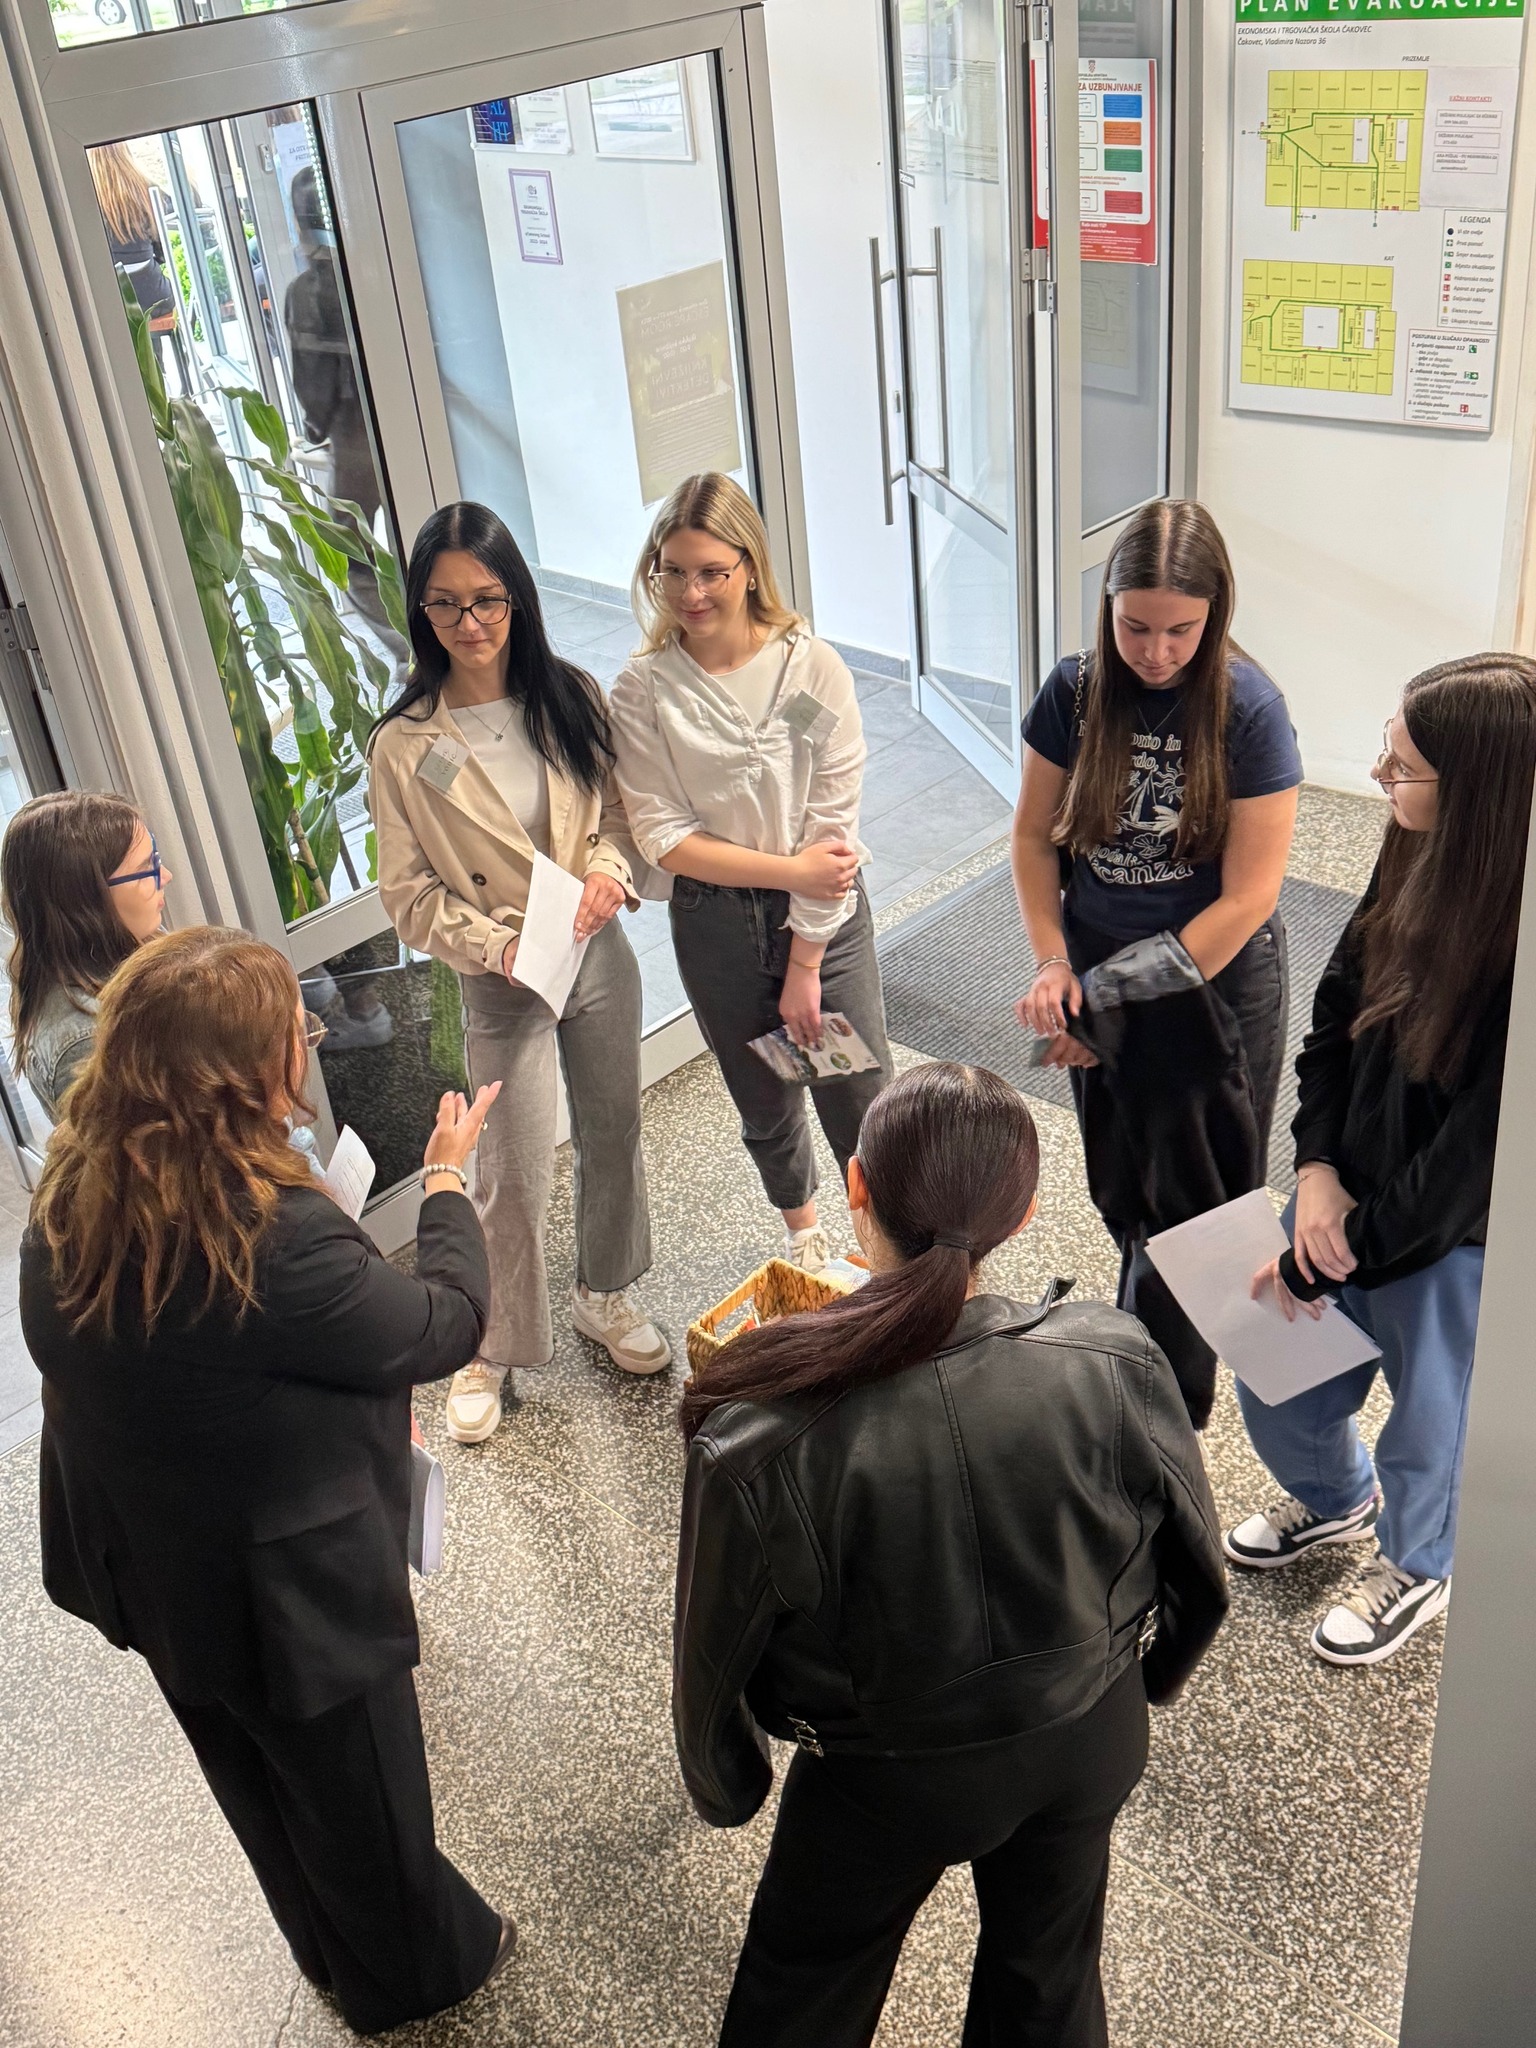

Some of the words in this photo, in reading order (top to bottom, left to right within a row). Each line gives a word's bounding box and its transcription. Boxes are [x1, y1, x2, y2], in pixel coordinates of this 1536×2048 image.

[1240, 0, 1309, 13] PLAN
[1238, 27, 1276, 35] EKONOMSKA
[1282, 26, 1320, 34] TRGOVAČKA
[1320, 25, 1340, 34] ŠKOLA
[1342, 24, 1372, 33] ČAKOVEC
[1088, 83, 1142, 92] UZBUNJIVANJE
[1460, 216, 1491, 224] LEGENDA
[1164, 734, 1182, 751] in
